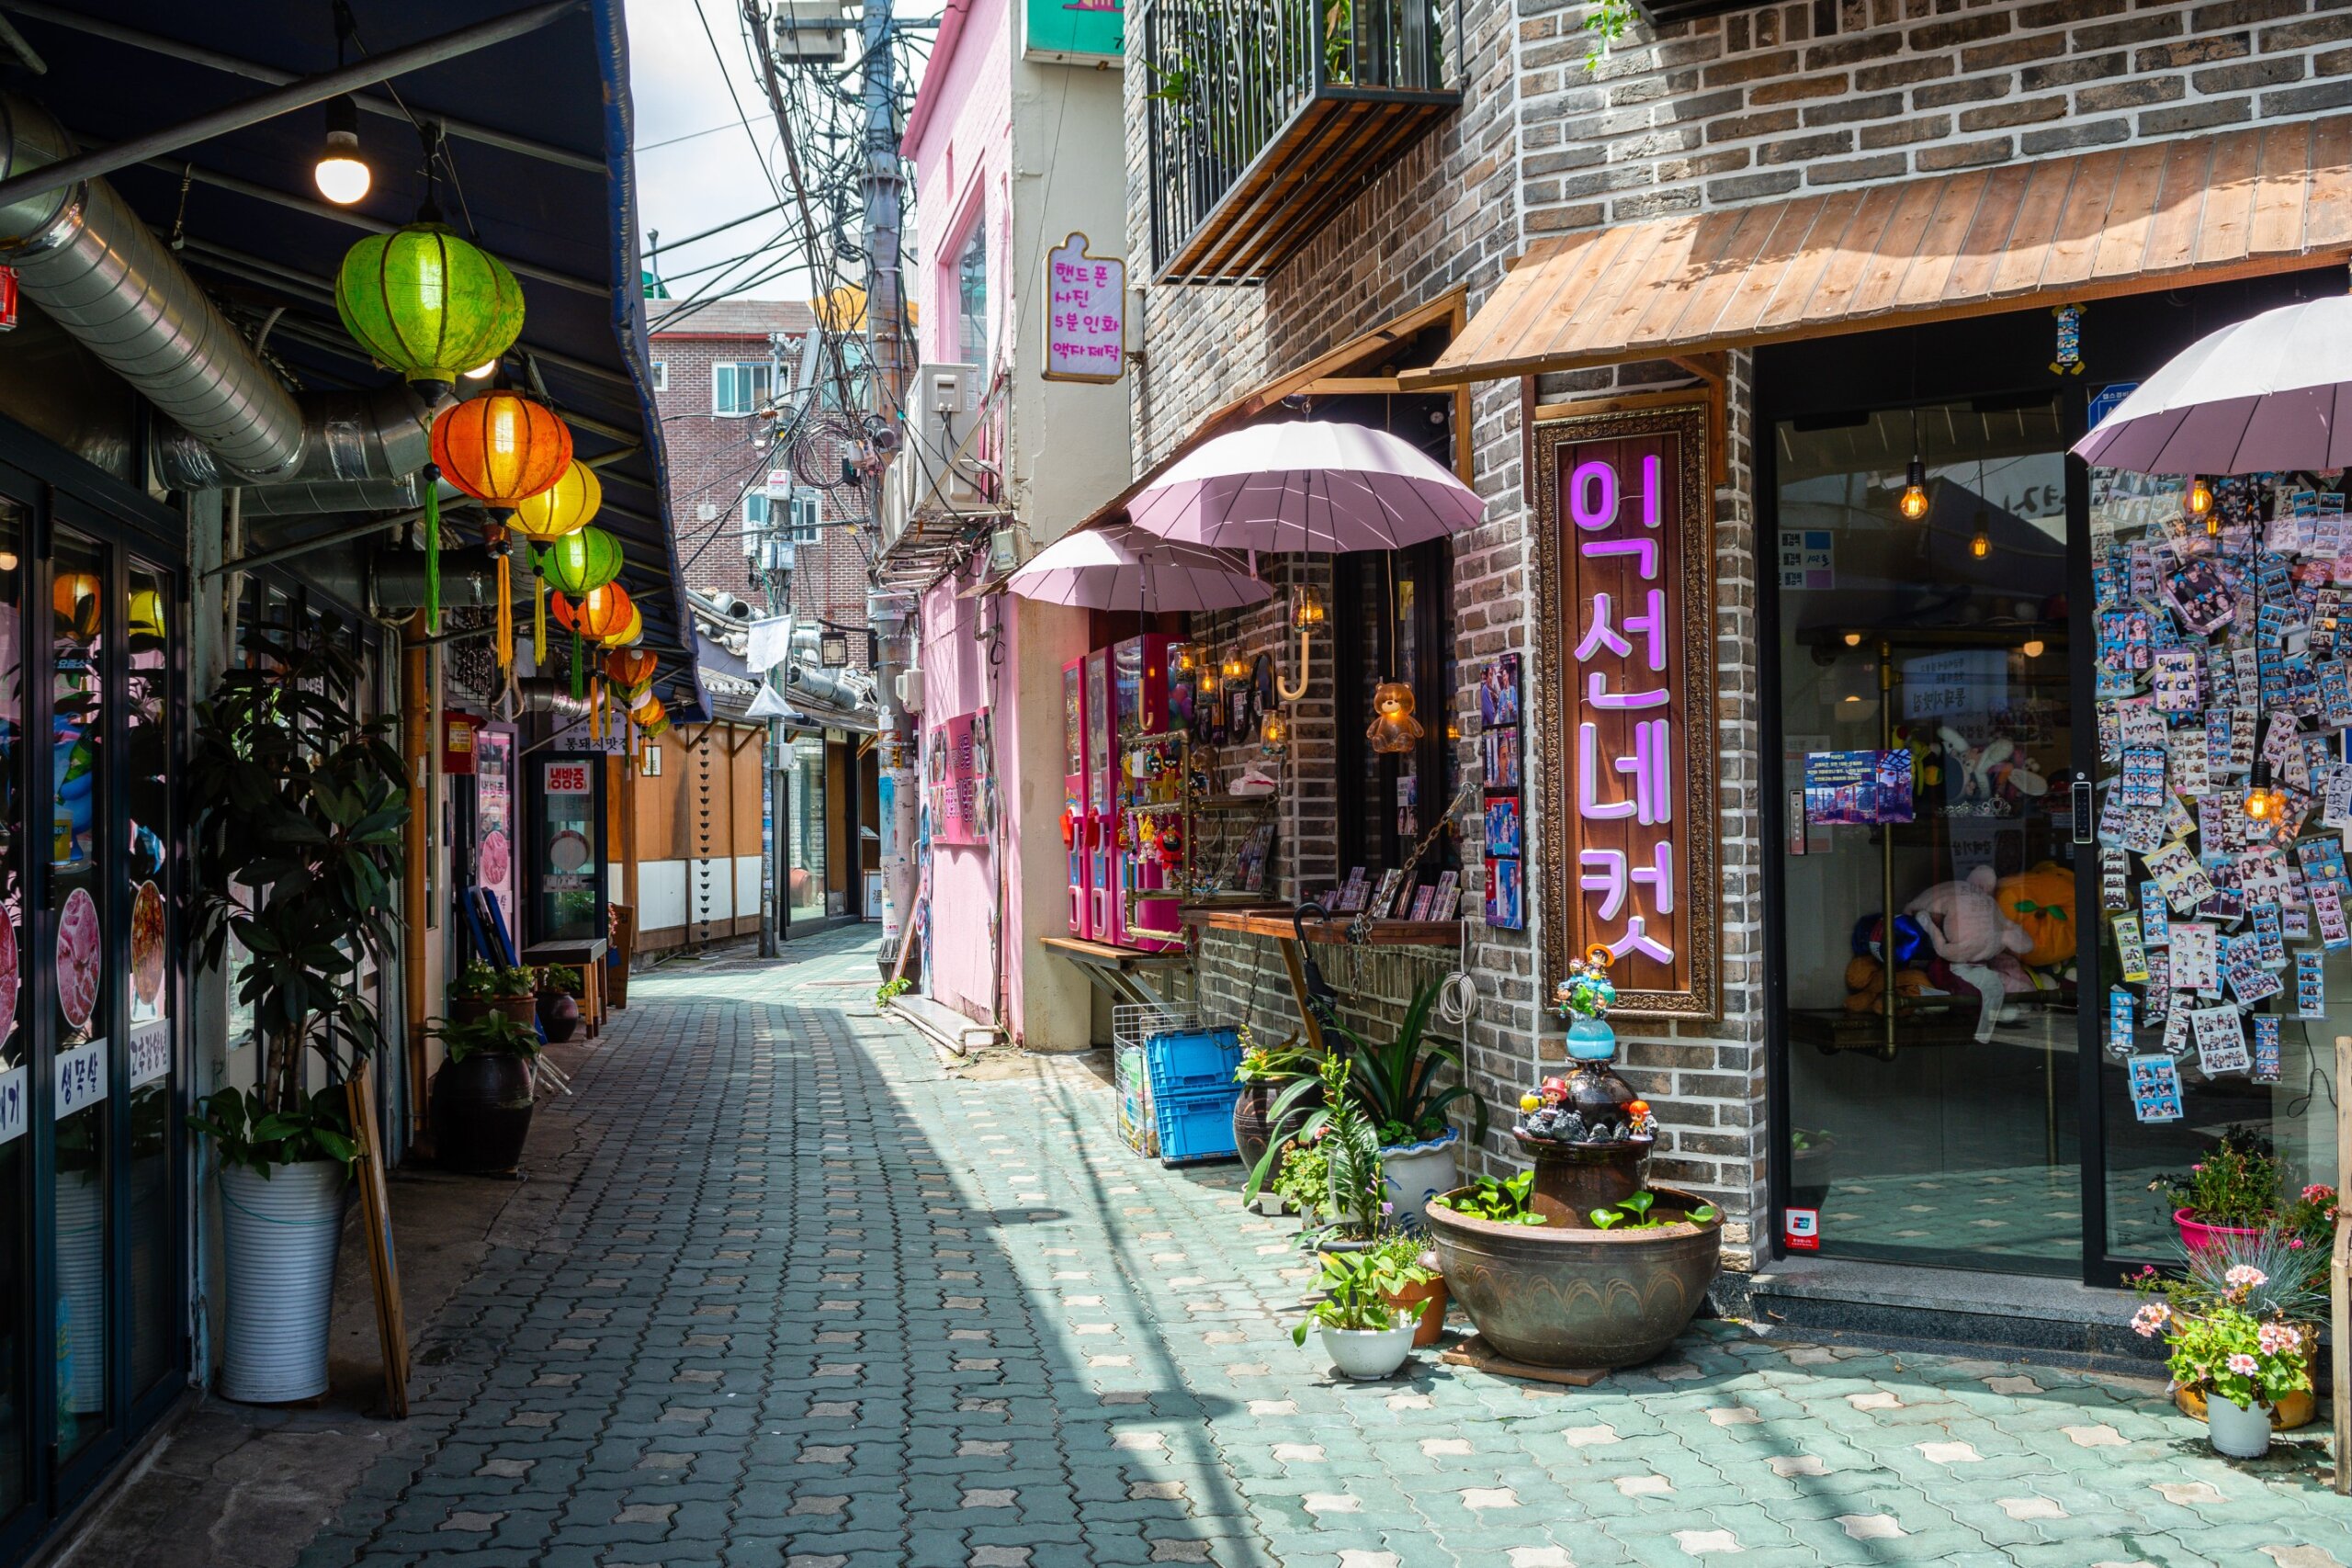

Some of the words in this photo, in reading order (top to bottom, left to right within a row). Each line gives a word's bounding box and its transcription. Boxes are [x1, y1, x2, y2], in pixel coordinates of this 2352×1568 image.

[1055, 289, 1090, 308] 사진
[1570, 454, 1674, 965] 익선네컷
[549, 768, 583, 790] 냉방중
[62, 1052, 98, 1105] 생목살
